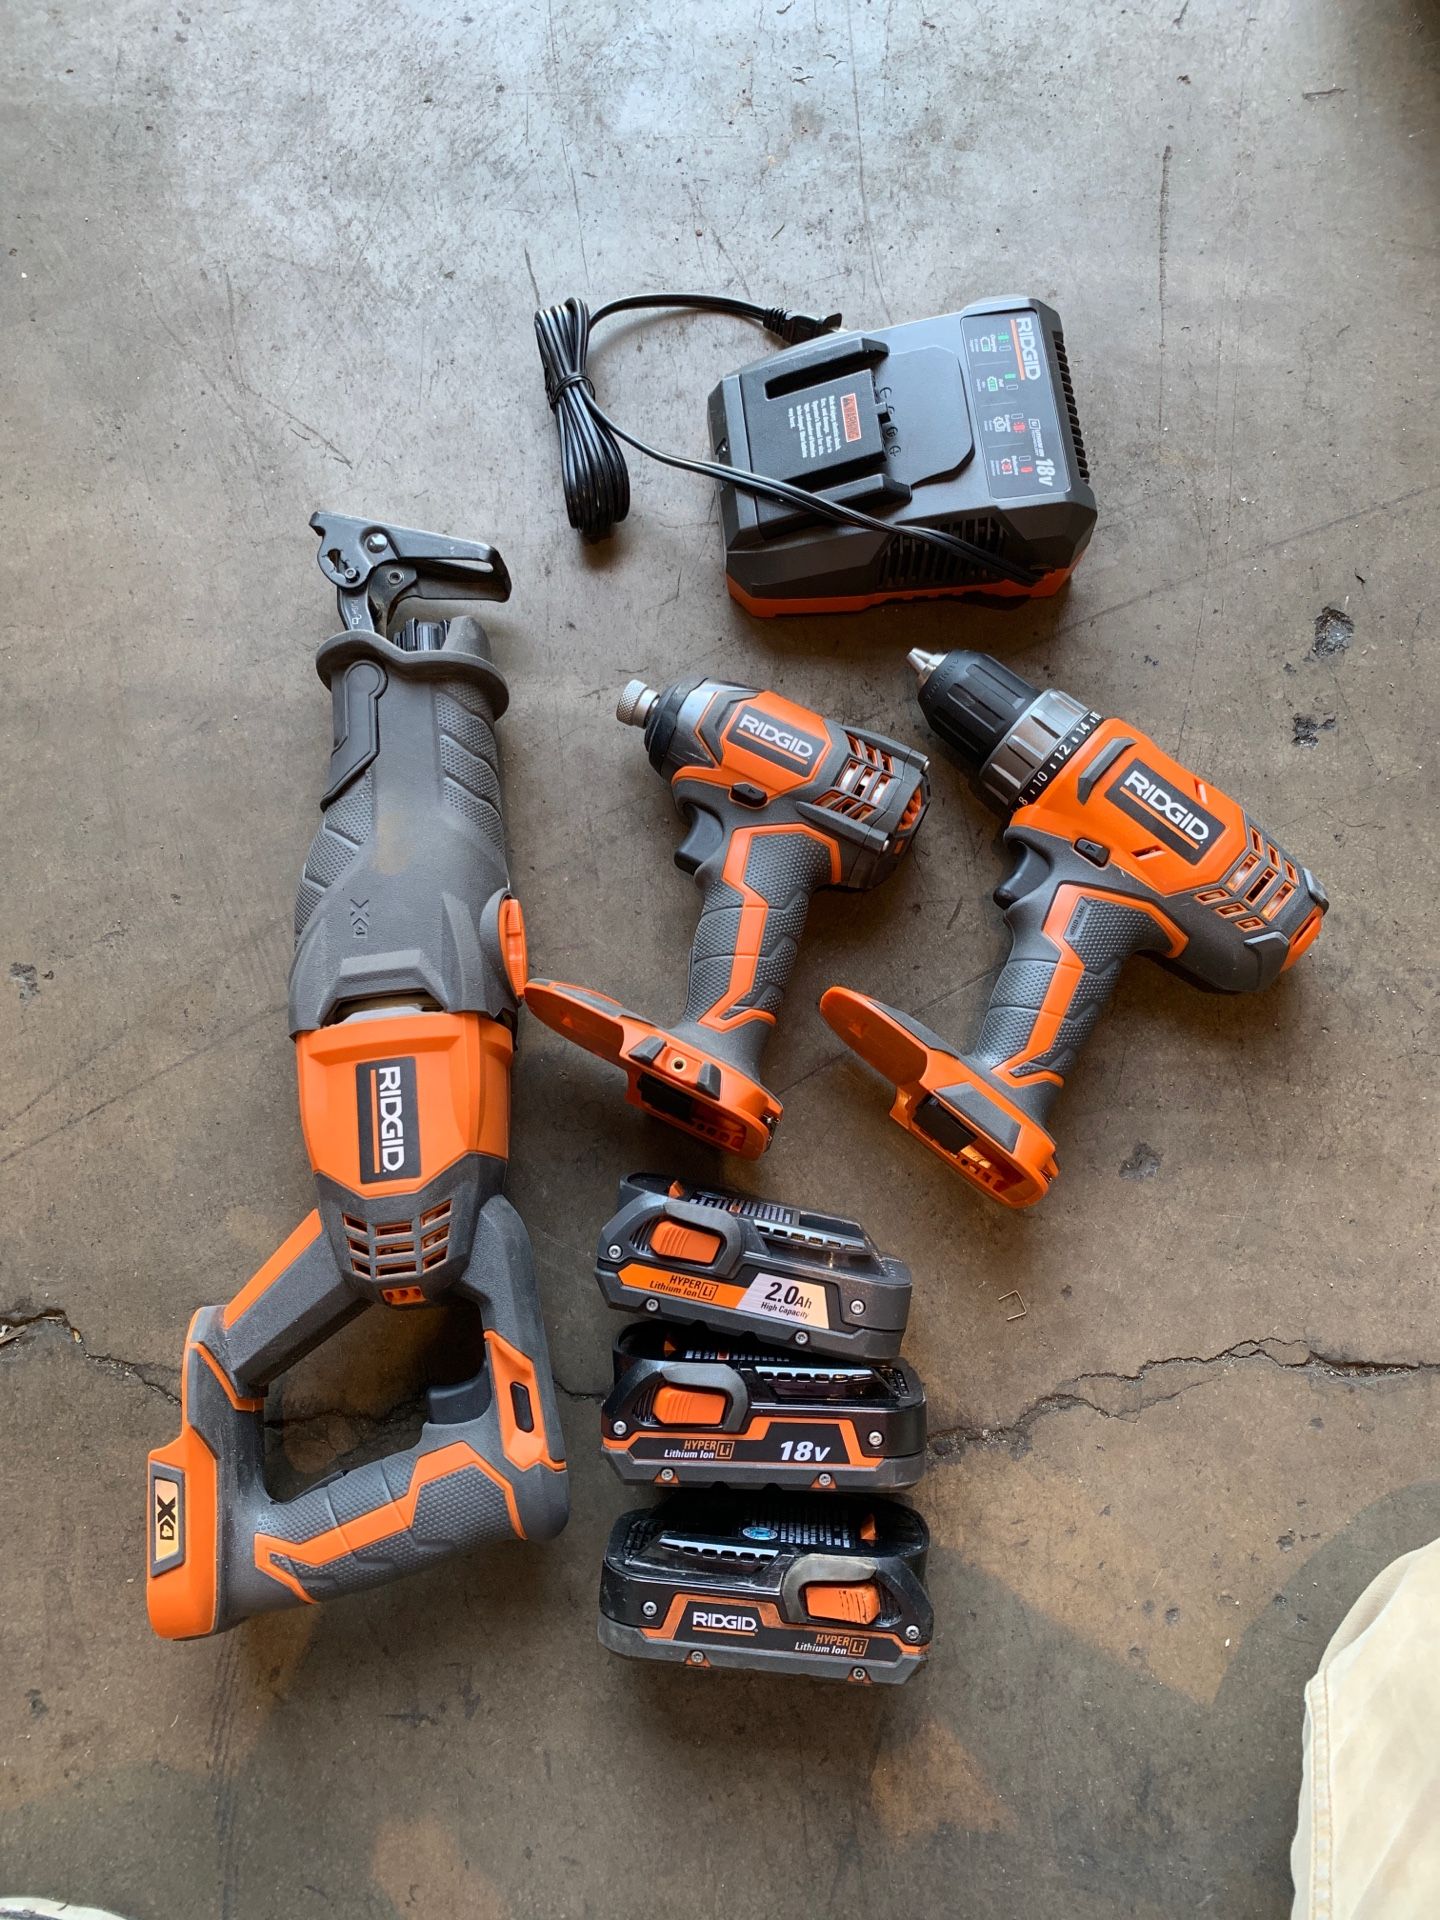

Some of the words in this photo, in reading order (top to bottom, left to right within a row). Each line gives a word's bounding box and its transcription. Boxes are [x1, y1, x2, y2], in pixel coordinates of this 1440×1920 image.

[1016, 317, 1041, 381] RIDGID
[739, 713, 813, 759] RIDGID
[1018, 796, 1028, 805] 8
[1033, 771, 1048, 787] 10
[1054, 744, 1071, 760] 12
[1076, 722, 1091, 735] 14
[1123, 770, 1210, 843] RIDGID
[379, 1066, 405, 1171] RIDGID
[649, 1280, 681, 1296] Lithium
[681, 1285, 698, 1298] Ion
[669, 1274, 702, 1291] HYPER
[703, 1284, 716, 1298] Li
[764, 1281, 813, 1309] 2.0Ah
[760, 1301, 777, 1314] High
[777, 1304, 810, 1319] Capacity
[664, 1449, 699, 1459] Lithium
[700, 1449, 715, 1460] Ion
[683, 1439, 717, 1451] HYPER
[719, 1443, 731, 1457] Li
[157, 1494, 176, 1540] X4
[692, 1611, 757, 1631] RIDGID
[795, 1641, 830, 1654] Lithium
[831, 1645, 848, 1655] Ion
[815, 1633, 850, 1648] HYPER
[852, 1640, 865, 1654] Li
